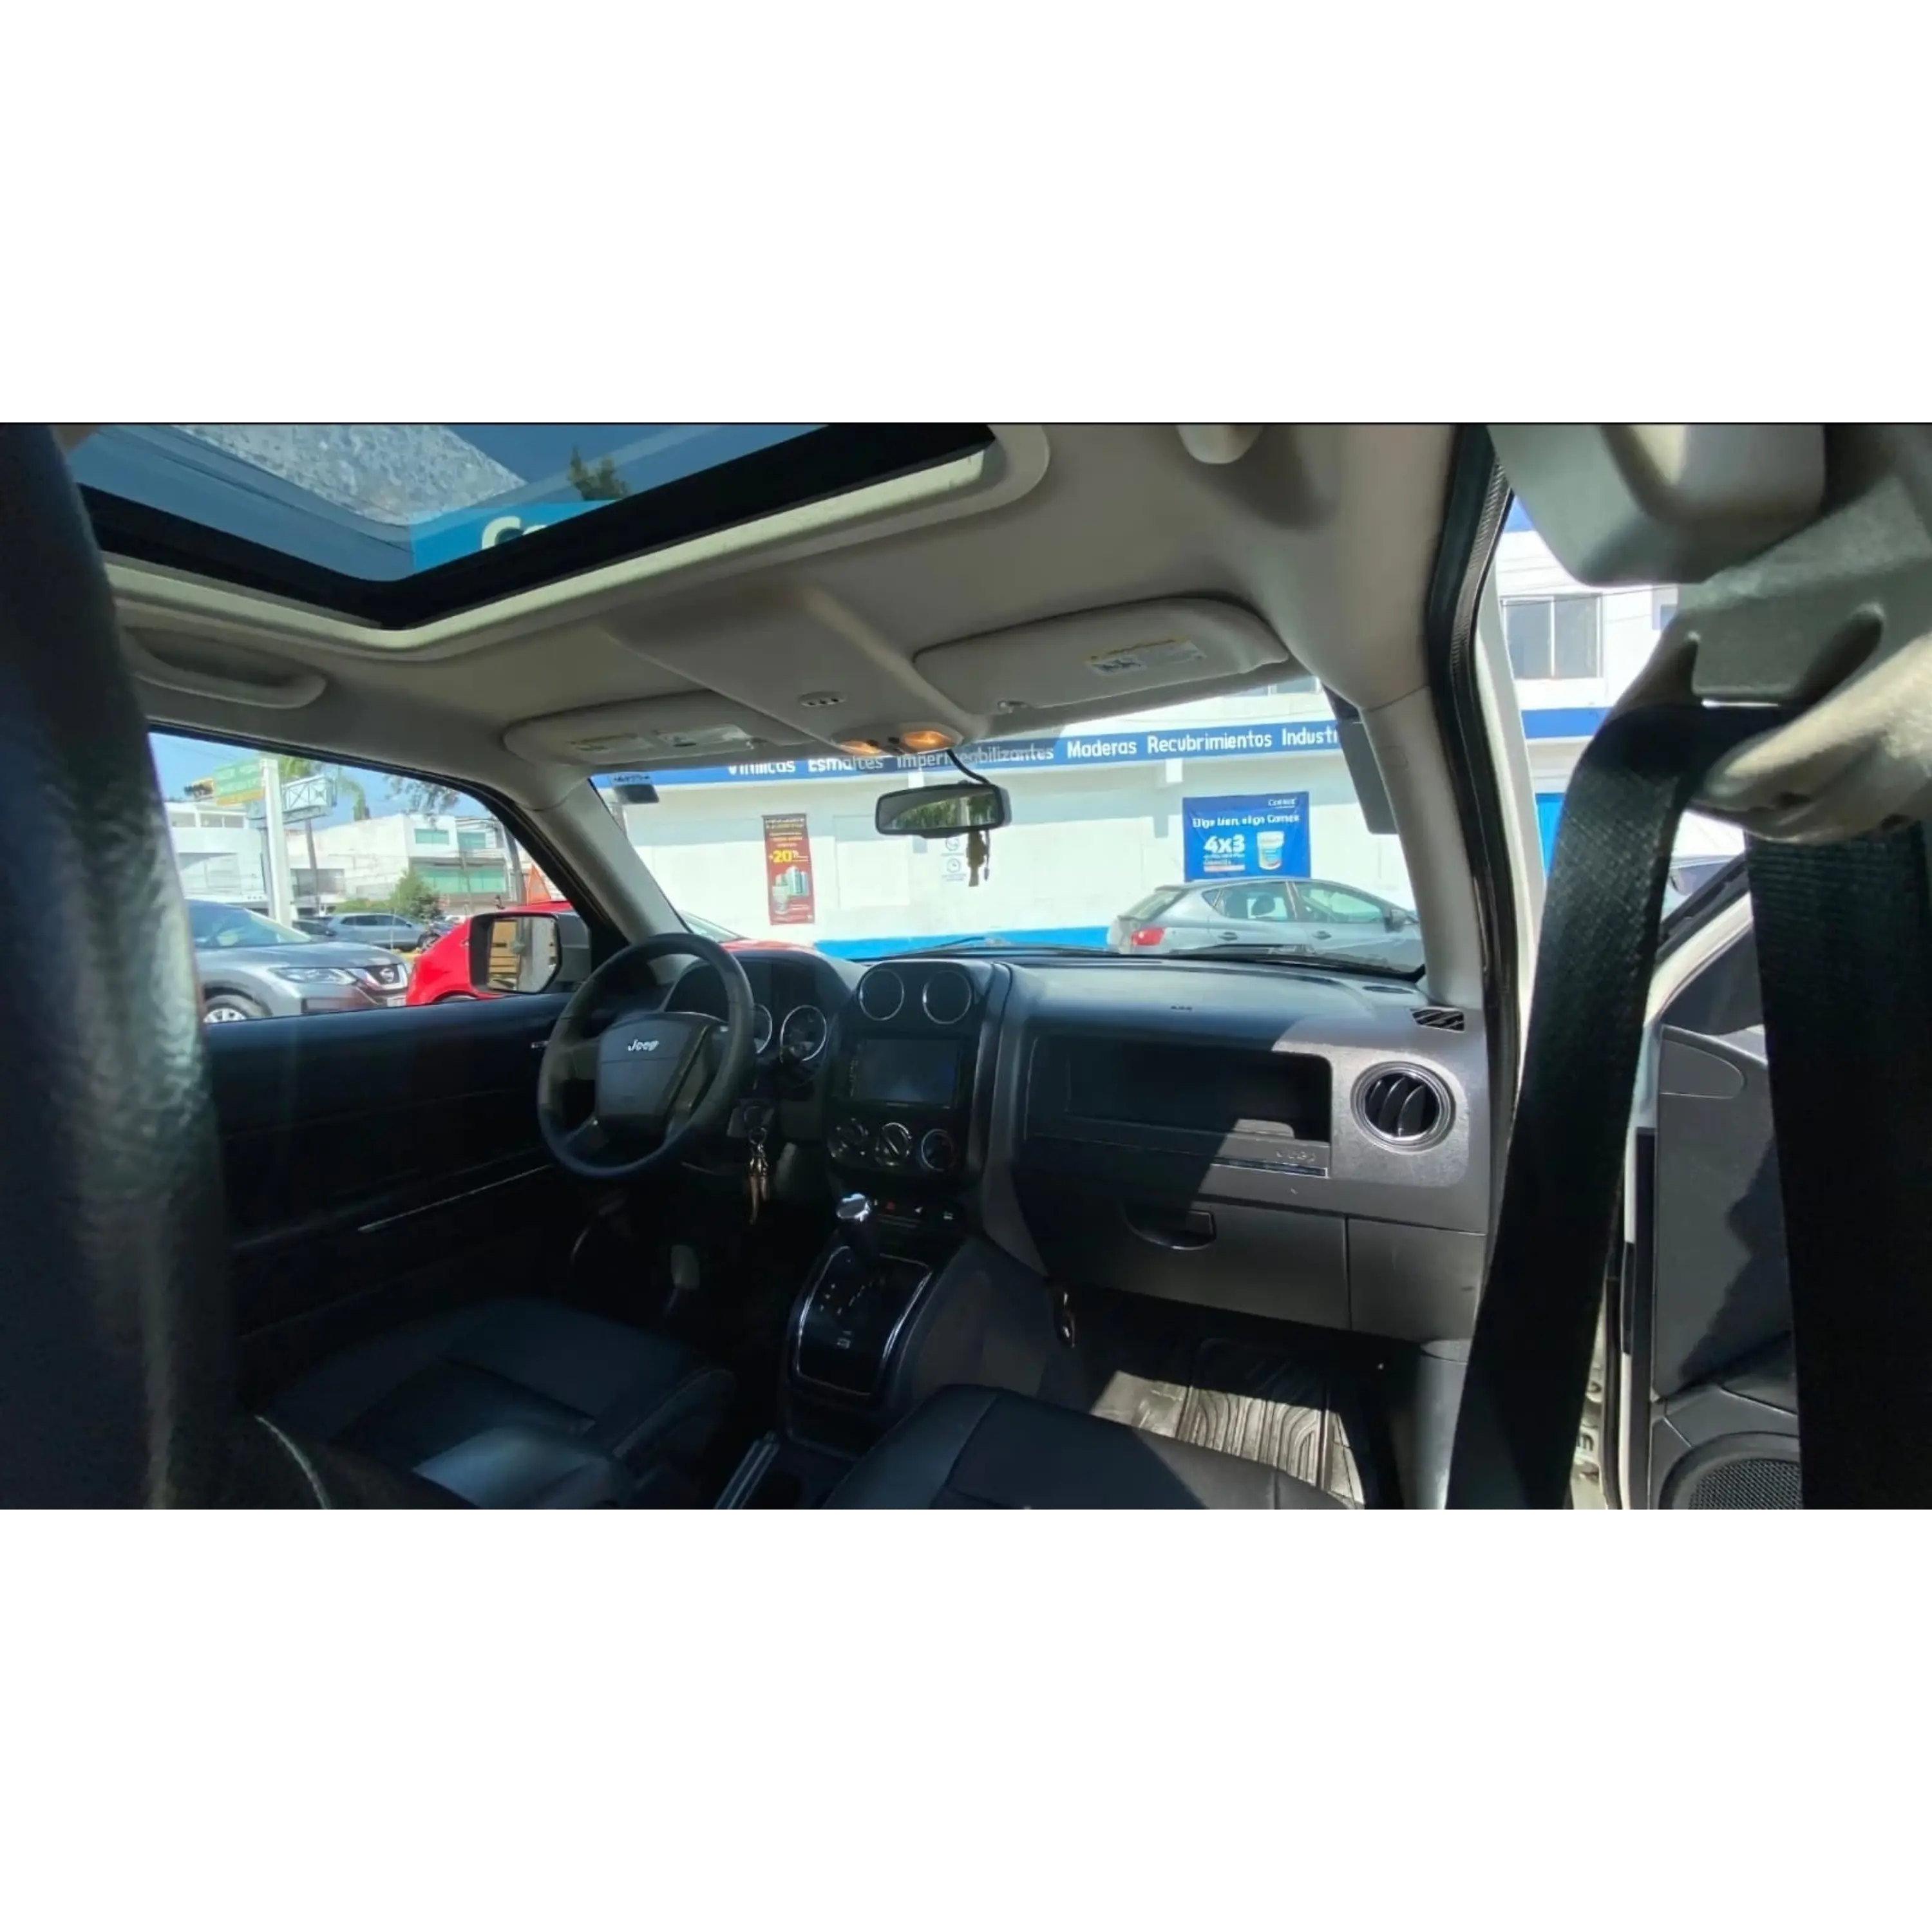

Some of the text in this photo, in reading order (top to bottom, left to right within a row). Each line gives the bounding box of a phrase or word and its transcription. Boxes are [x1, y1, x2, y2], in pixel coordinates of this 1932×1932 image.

[808, 755, 884, 772] Esmaltes
[1066, 740, 1137, 759] Maderas
[1147, 729, 1272, 753] Recubrimientos
[1204, 834, 1245, 854] 4x3
